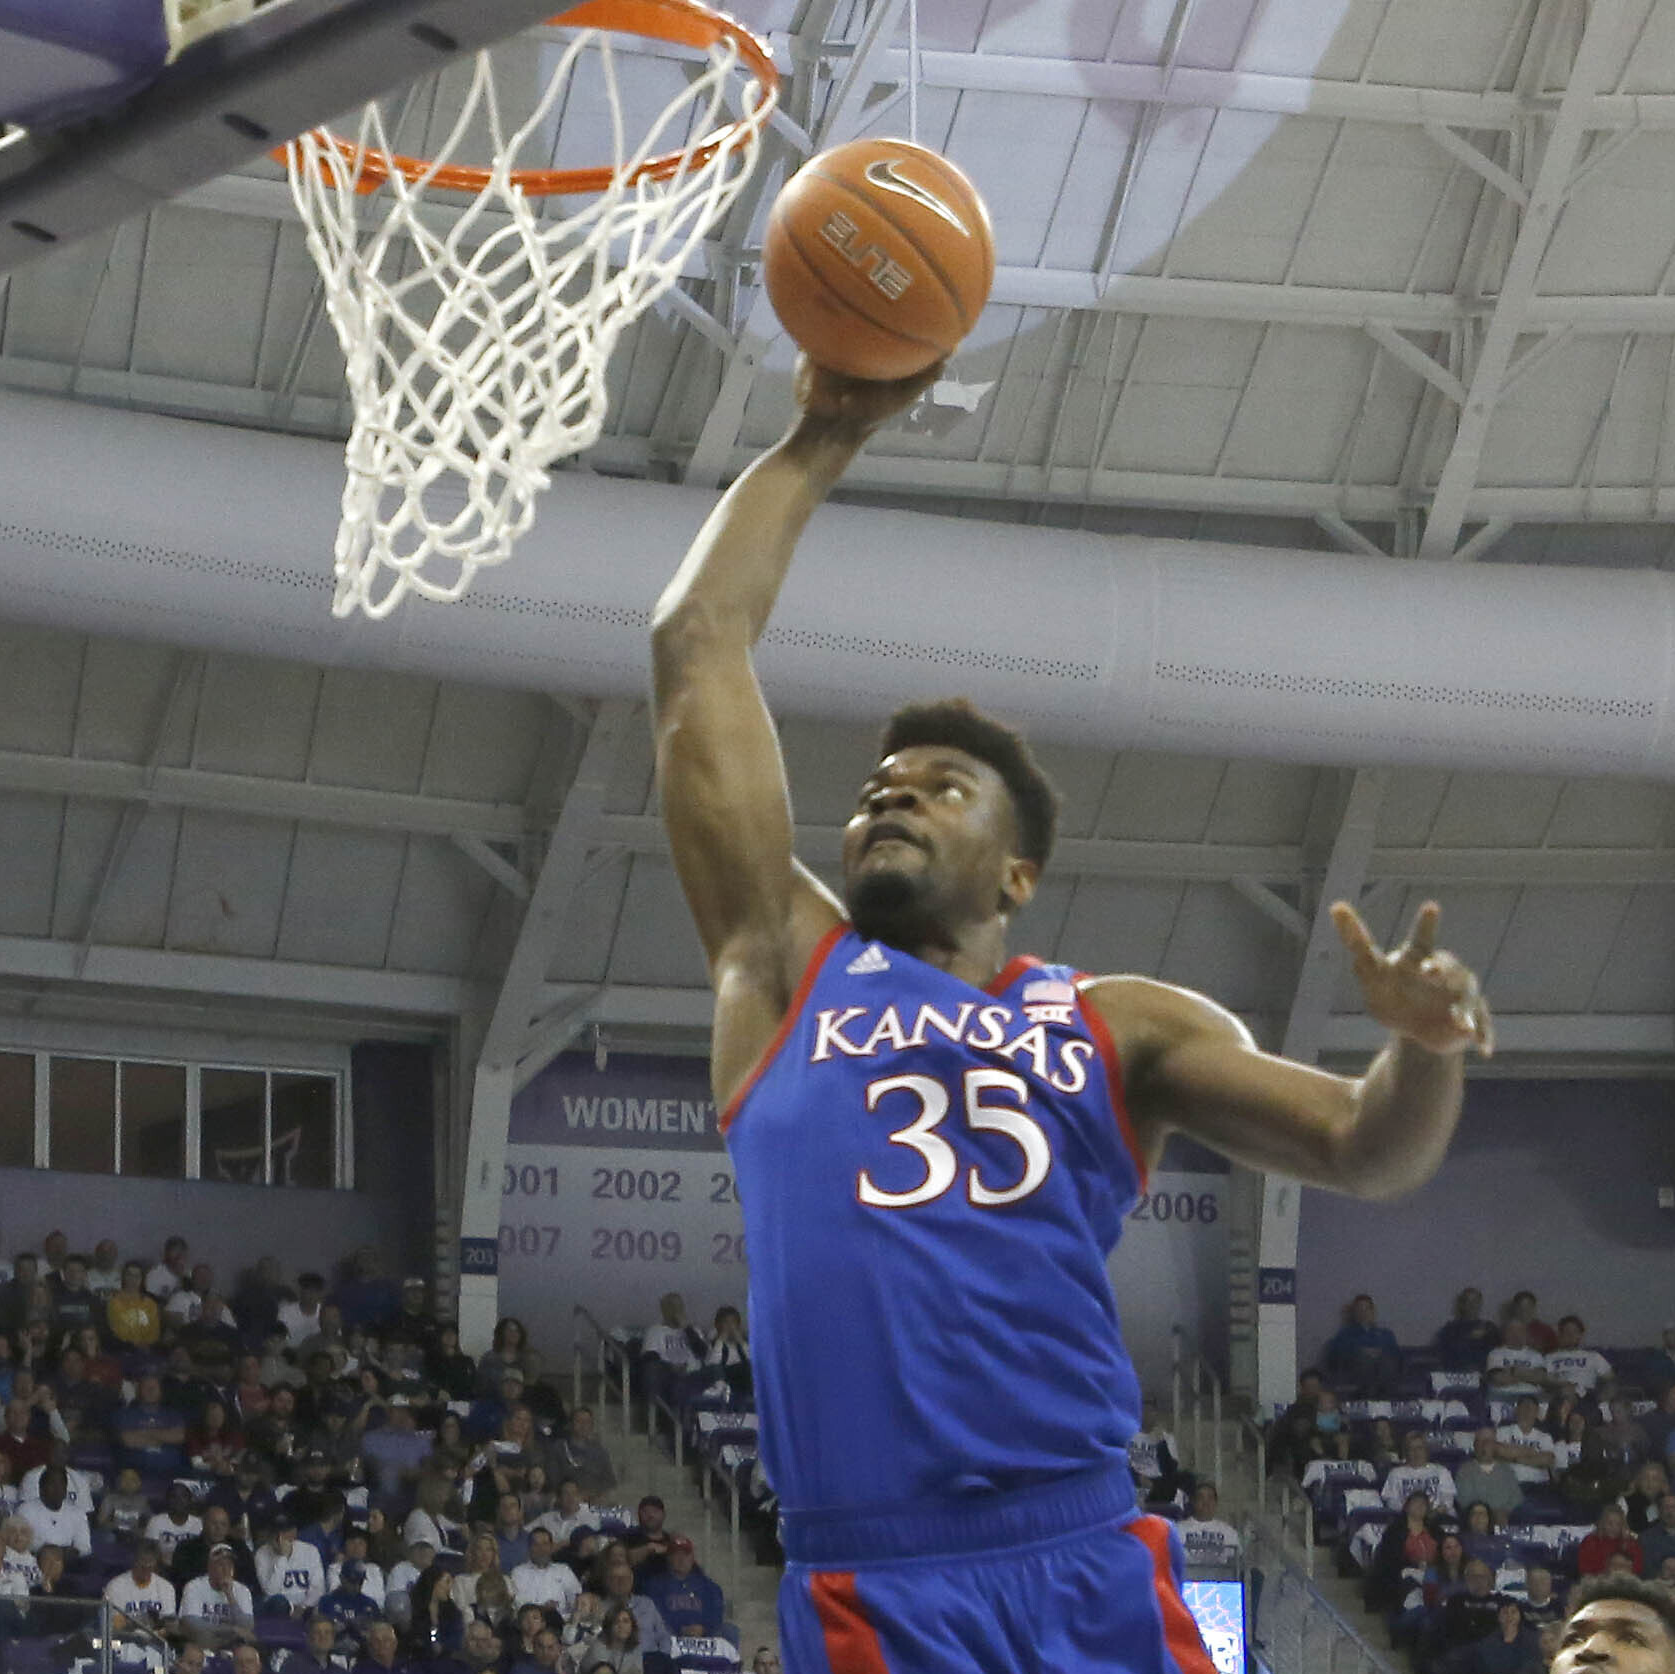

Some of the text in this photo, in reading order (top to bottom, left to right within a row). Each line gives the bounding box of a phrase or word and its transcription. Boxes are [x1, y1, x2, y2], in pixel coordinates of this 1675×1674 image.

[819, 211, 915, 301] ELITE
[810, 1002, 1095, 1096] KANSAS
[562, 1096, 716, 1134] WOMEN'
[856, 1066, 1053, 1210] 35
[502, 1165, 559, 1197] 001
[591, 1167, 681, 1202] 2002
[1129, 1190, 1219, 1224] 2006
[498, 1226, 562, 1258] 007
[591, 1228, 682, 1263] 2009
